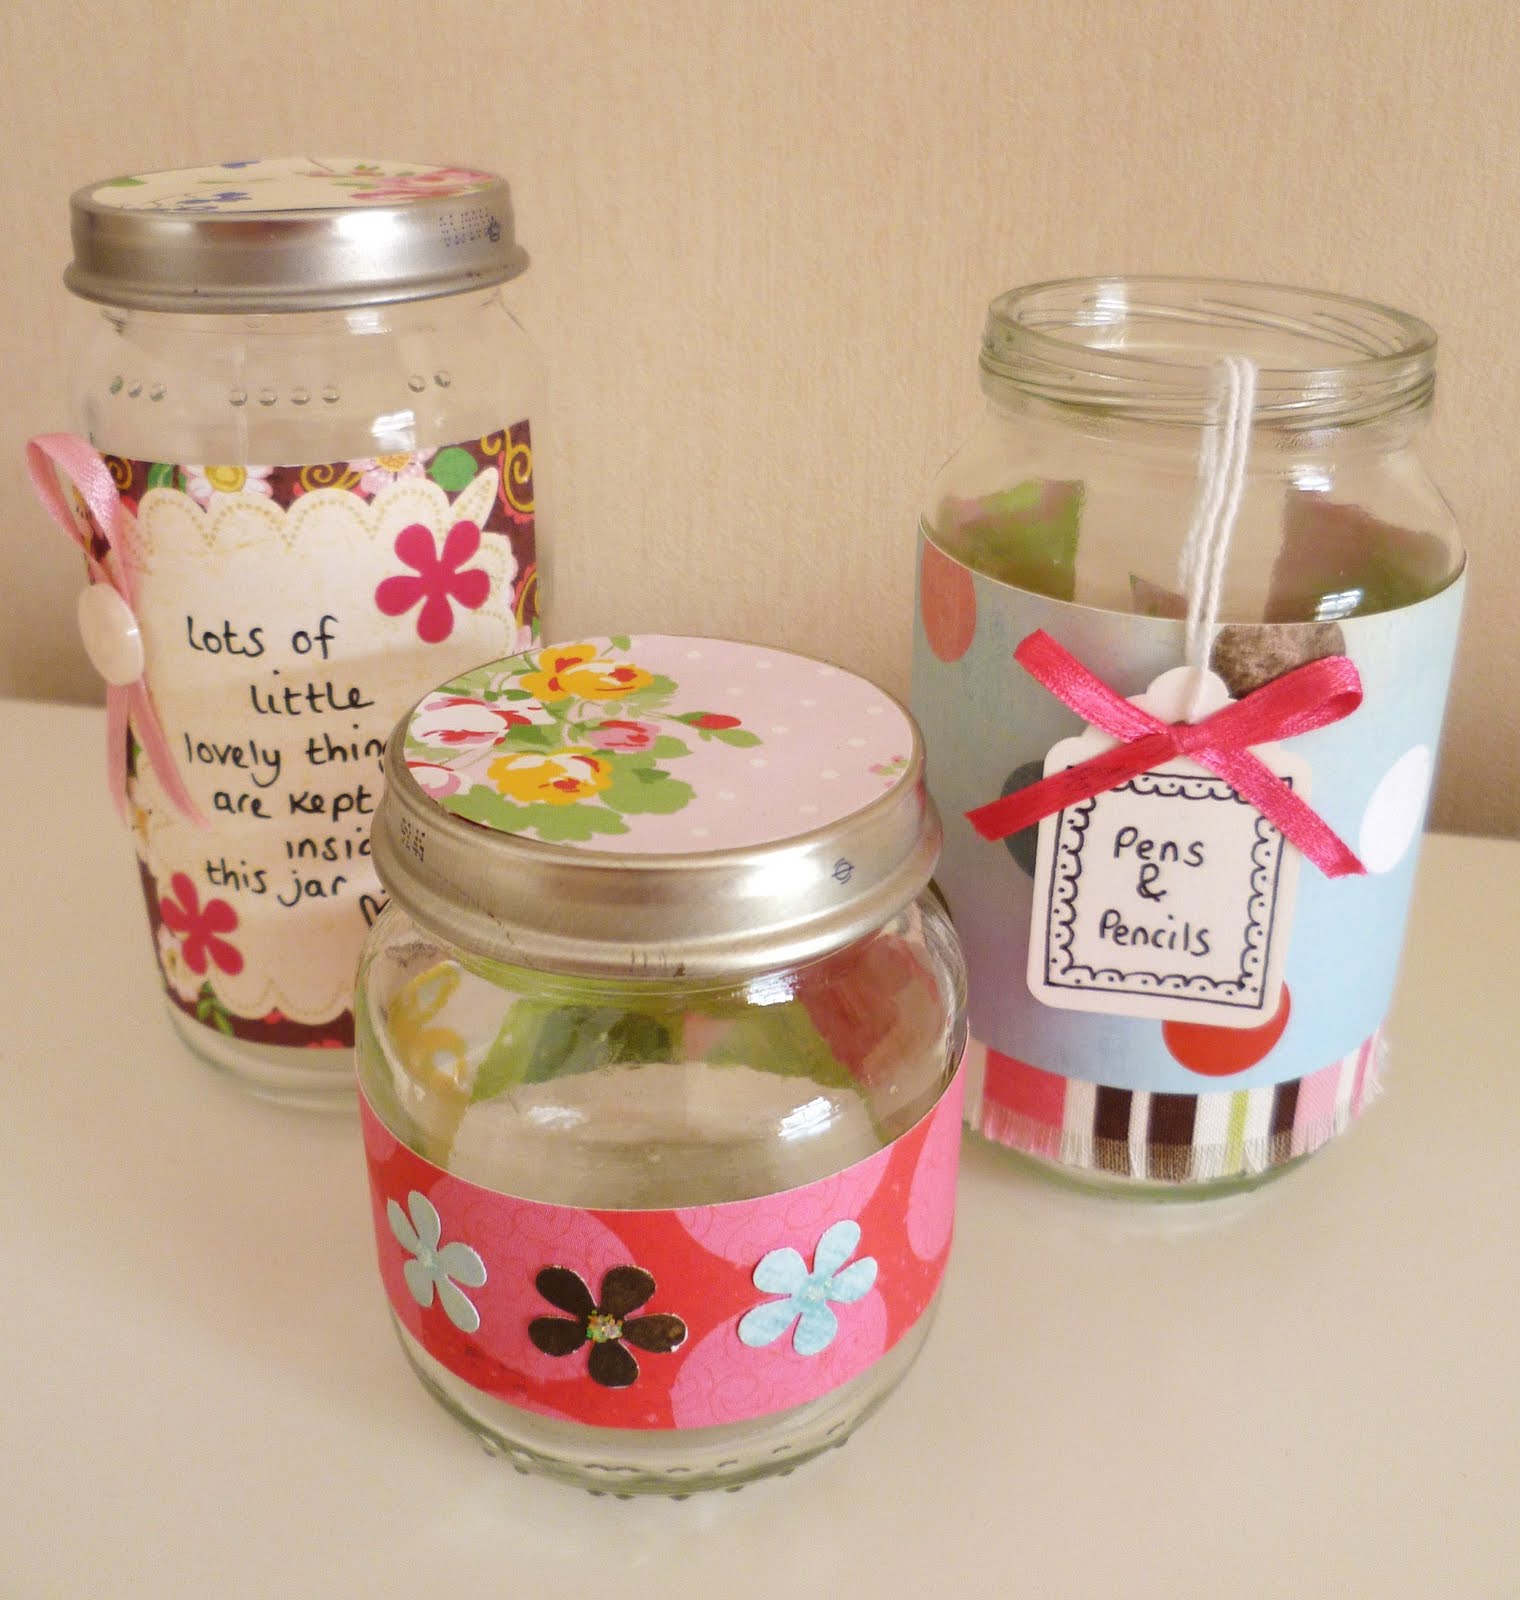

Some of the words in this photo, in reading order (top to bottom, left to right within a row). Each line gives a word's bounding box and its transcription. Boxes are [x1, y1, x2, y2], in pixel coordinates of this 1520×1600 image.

[187, 615, 265, 659] lots
[291, 614, 339, 660] of
[250, 669, 375, 716] little
[184, 732, 281, 788] lovely
[213, 791, 272, 818] are
[289, 785, 374, 822] kept
[1113, 826, 1205, 867] Pens
[206, 858, 267, 894] this
[277, 870, 348, 908] jar
[1136, 863, 1167, 902] &
[1099, 909, 1210, 957] Pencils
